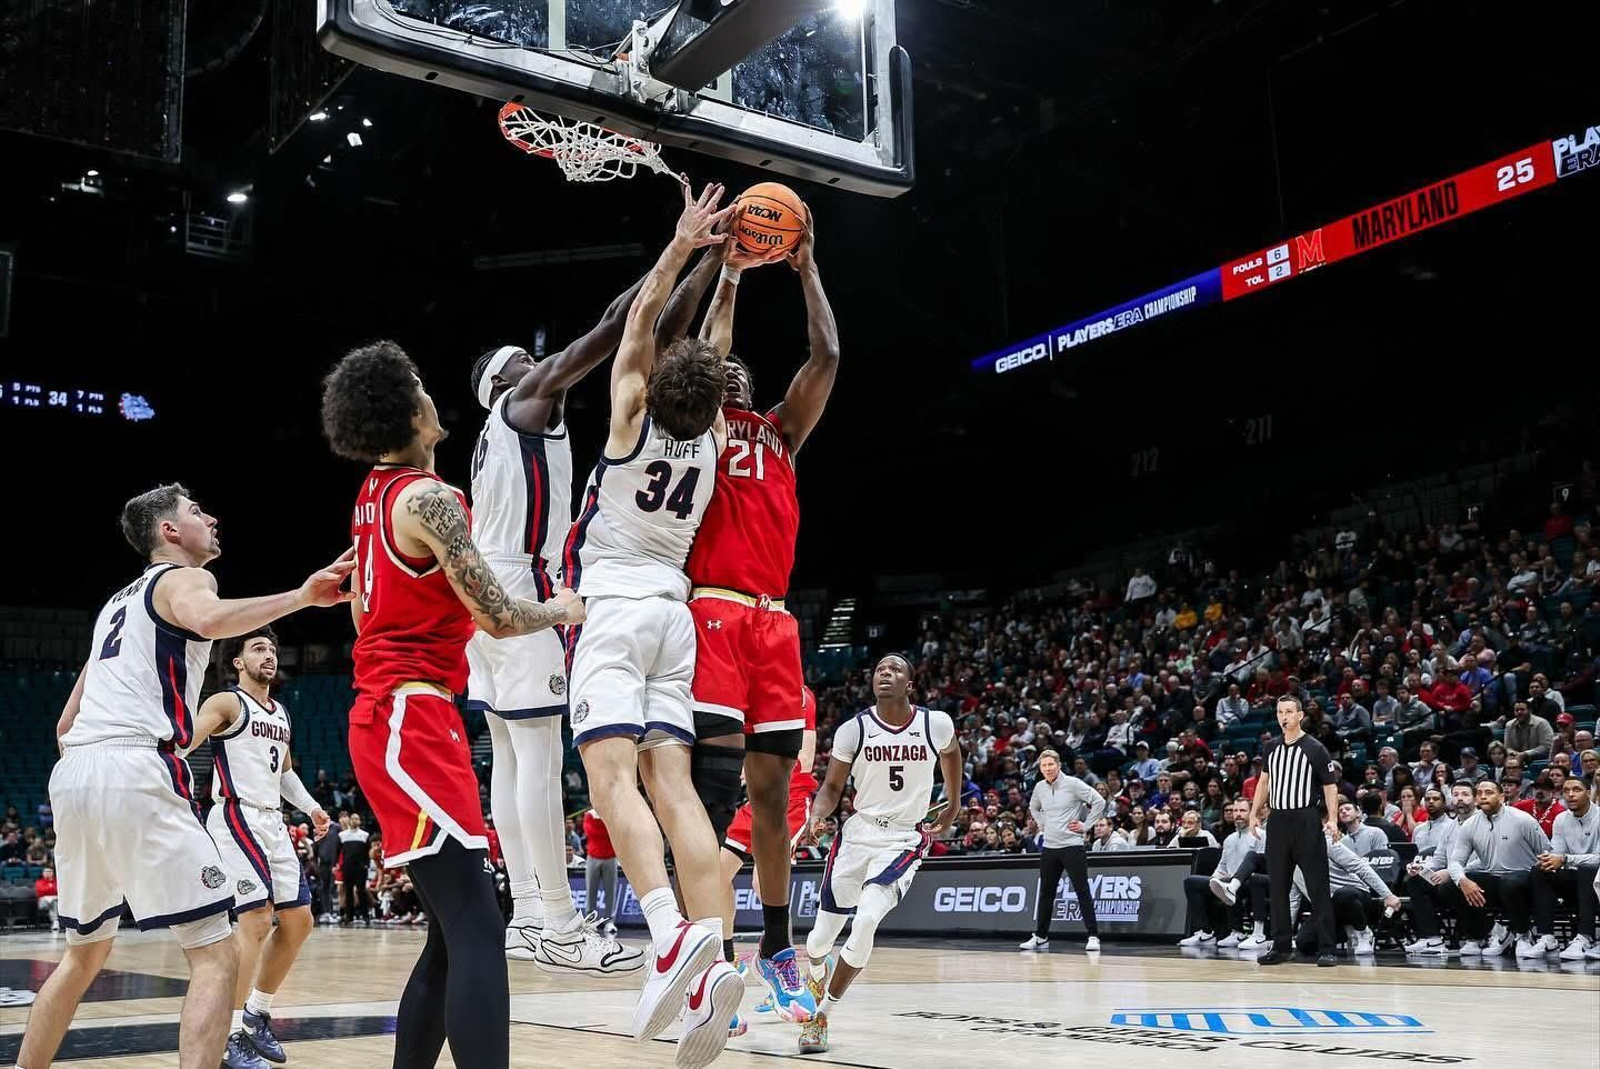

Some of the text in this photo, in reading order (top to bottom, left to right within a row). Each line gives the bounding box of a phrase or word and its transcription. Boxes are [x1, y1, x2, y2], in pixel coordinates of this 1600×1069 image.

[1351, 157, 1535, 249] MARYLAND 25
[1232, 249, 1281, 275] FOULS 6
[1245, 266, 1283, 287] TOL 2
[995, 343, 1047, 374] GEICO
[1144, 285, 1197, 319] CHAMPIONSHIP
[48, 391, 68, 406] 34
[77, 391, 84, 399] 7
[664, 440, 700, 459] HUFF
[727, 420, 783, 458] RYLAND
[728, 439, 765, 481] 21
[635, 460, 702, 520] 34
[99, 605, 127, 661] 2
[269, 745, 279, 774] 3
[864, 745, 928, 762] GONZAGA
[889, 766, 904, 791] 5
[933, 874, 1142, 913] GEICO PLYERS
[892, 1011, 1023, 1024] BOYS
[1065, 1026, 1241, 1043] GIRLS
[1240, 1041, 1476, 1064] CLUBS
[1023, 1031, 1219, 1052] AMERICA
